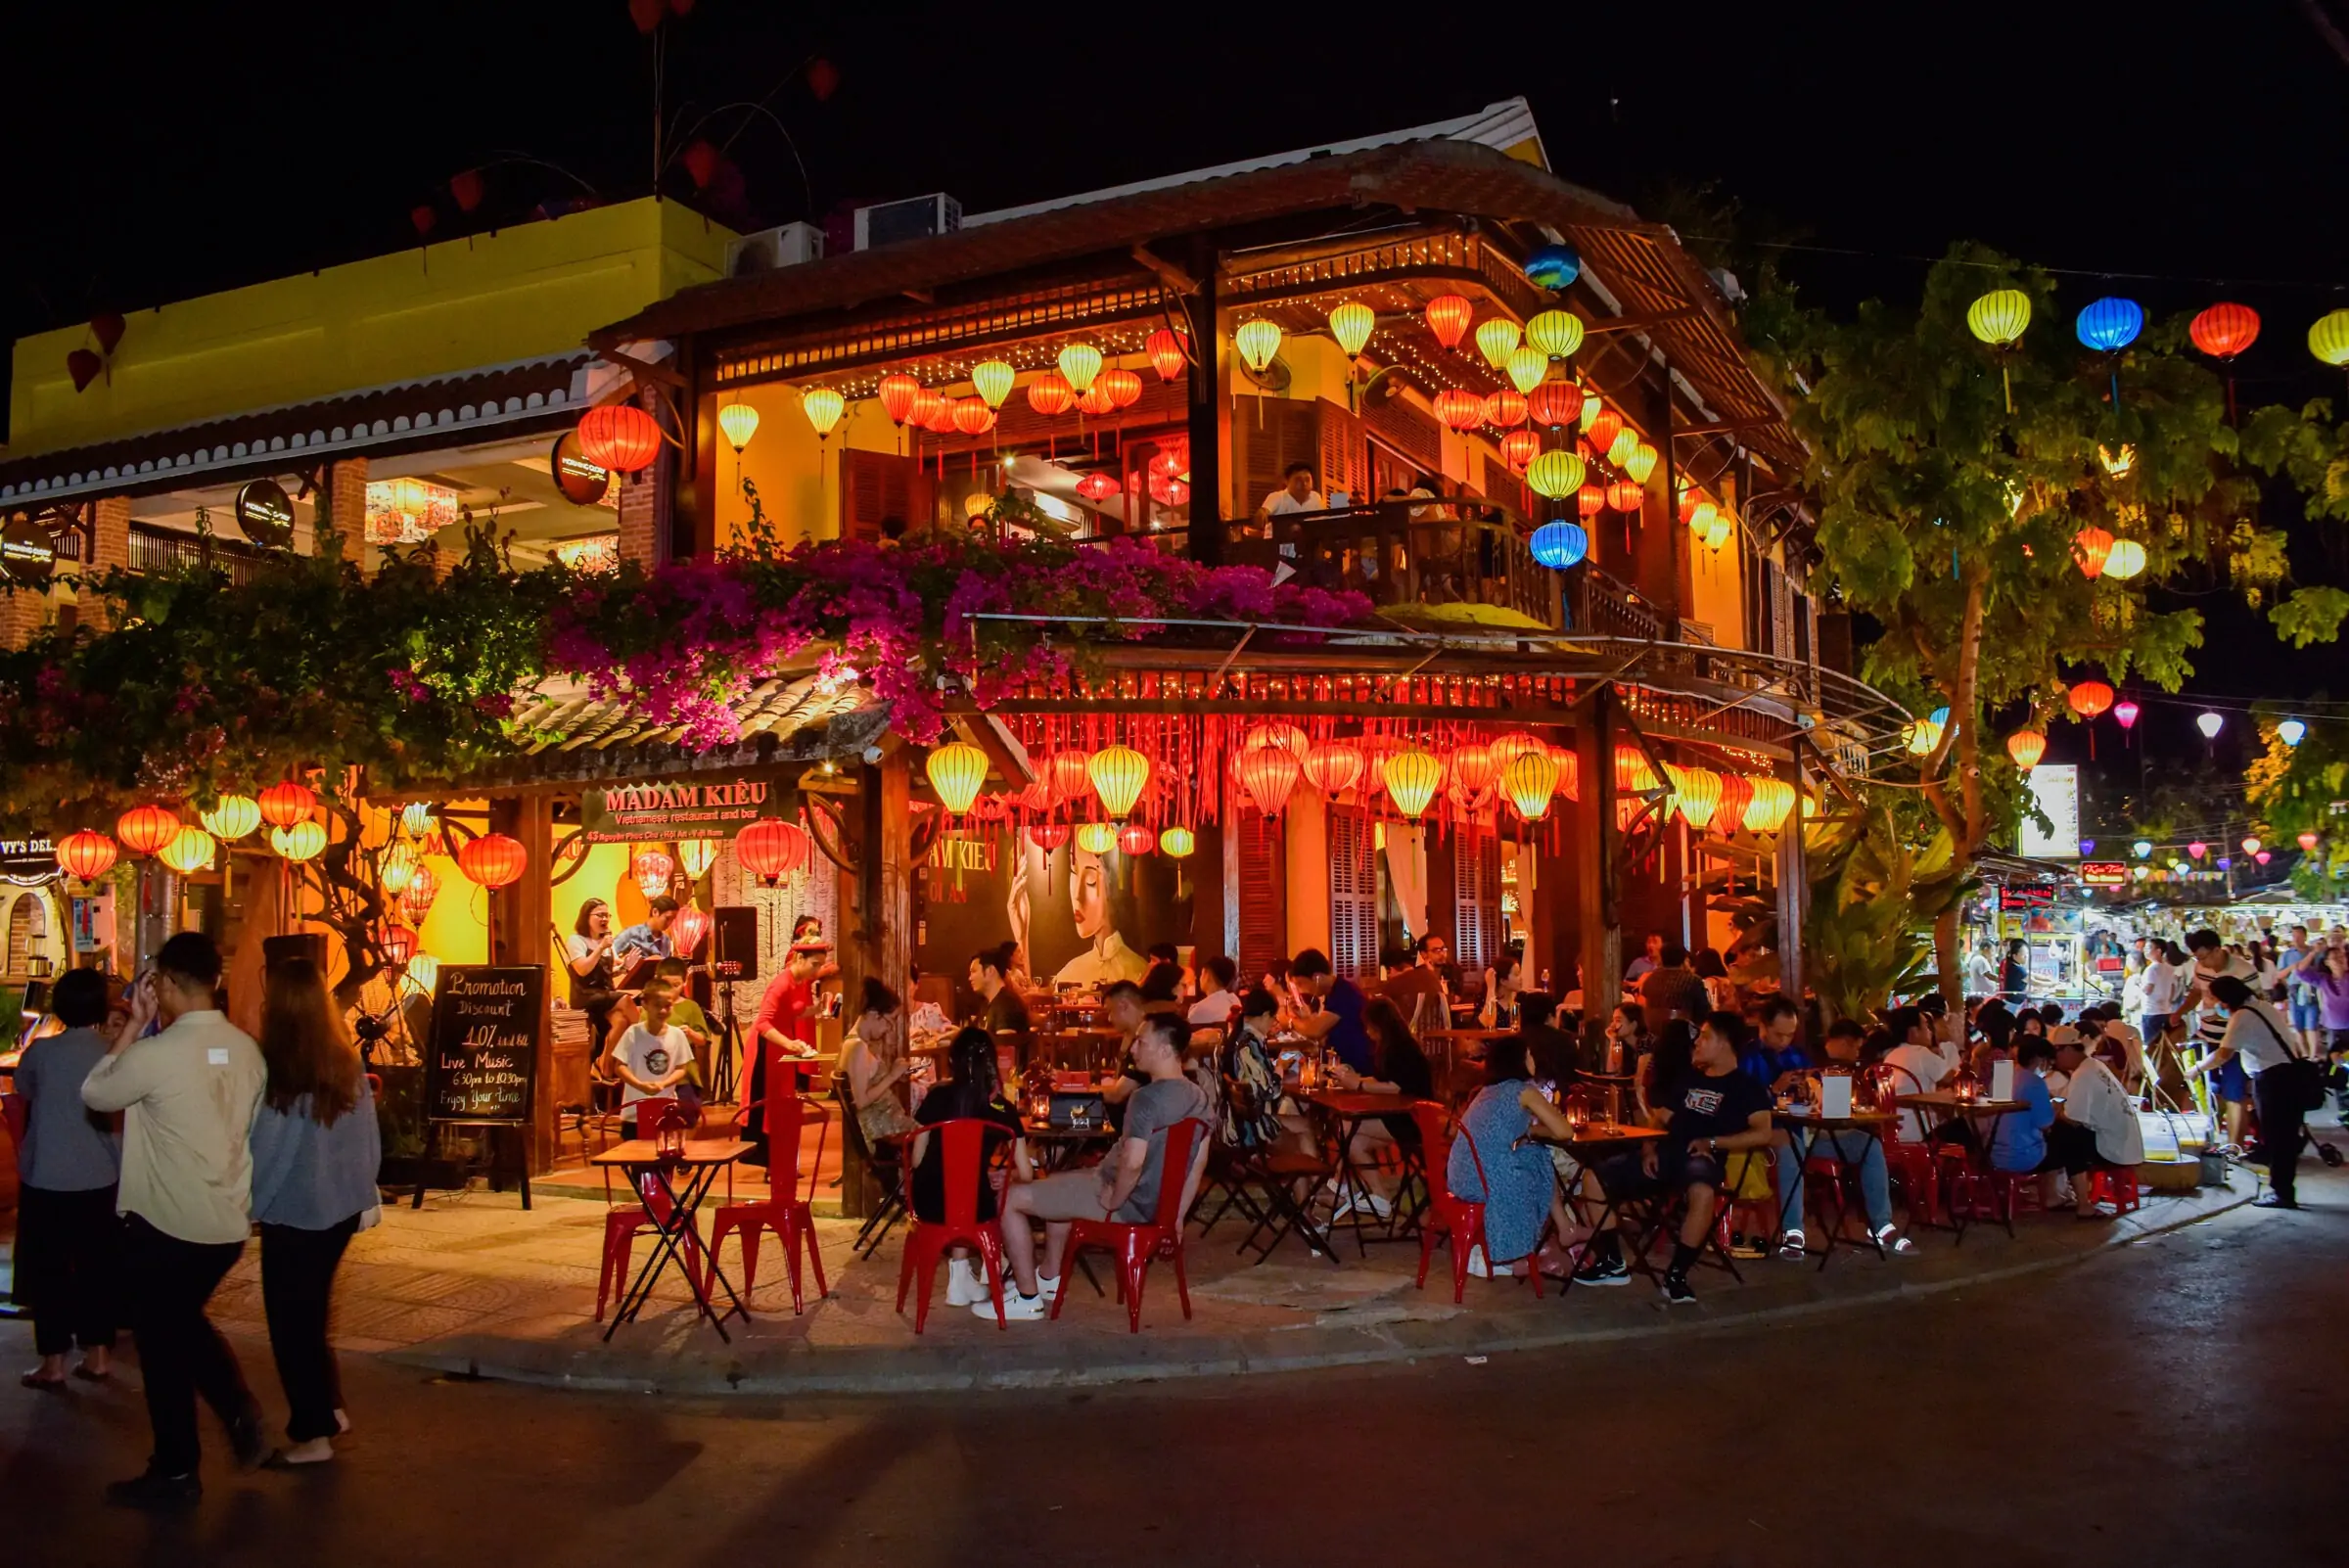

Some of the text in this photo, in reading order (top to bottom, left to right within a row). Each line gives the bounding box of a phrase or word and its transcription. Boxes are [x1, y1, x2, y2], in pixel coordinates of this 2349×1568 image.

[605, 785, 699, 812] MADAM
[615, 808, 758, 825] Vietnamese restaurant and bar
[586, 830, 599, 842] 43
[2, 840, 27, 854] VY'S
[446, 972, 527, 996] Promotion
[457, 999, 513, 1016] Discount
[462, 1024, 498, 1048] 10%
[440, 1051, 514, 1069] Live Music
[484, 1072, 494, 1084] to
[440, 1089, 466, 1112] Enjoy
[494, 1086, 521, 1104] time
